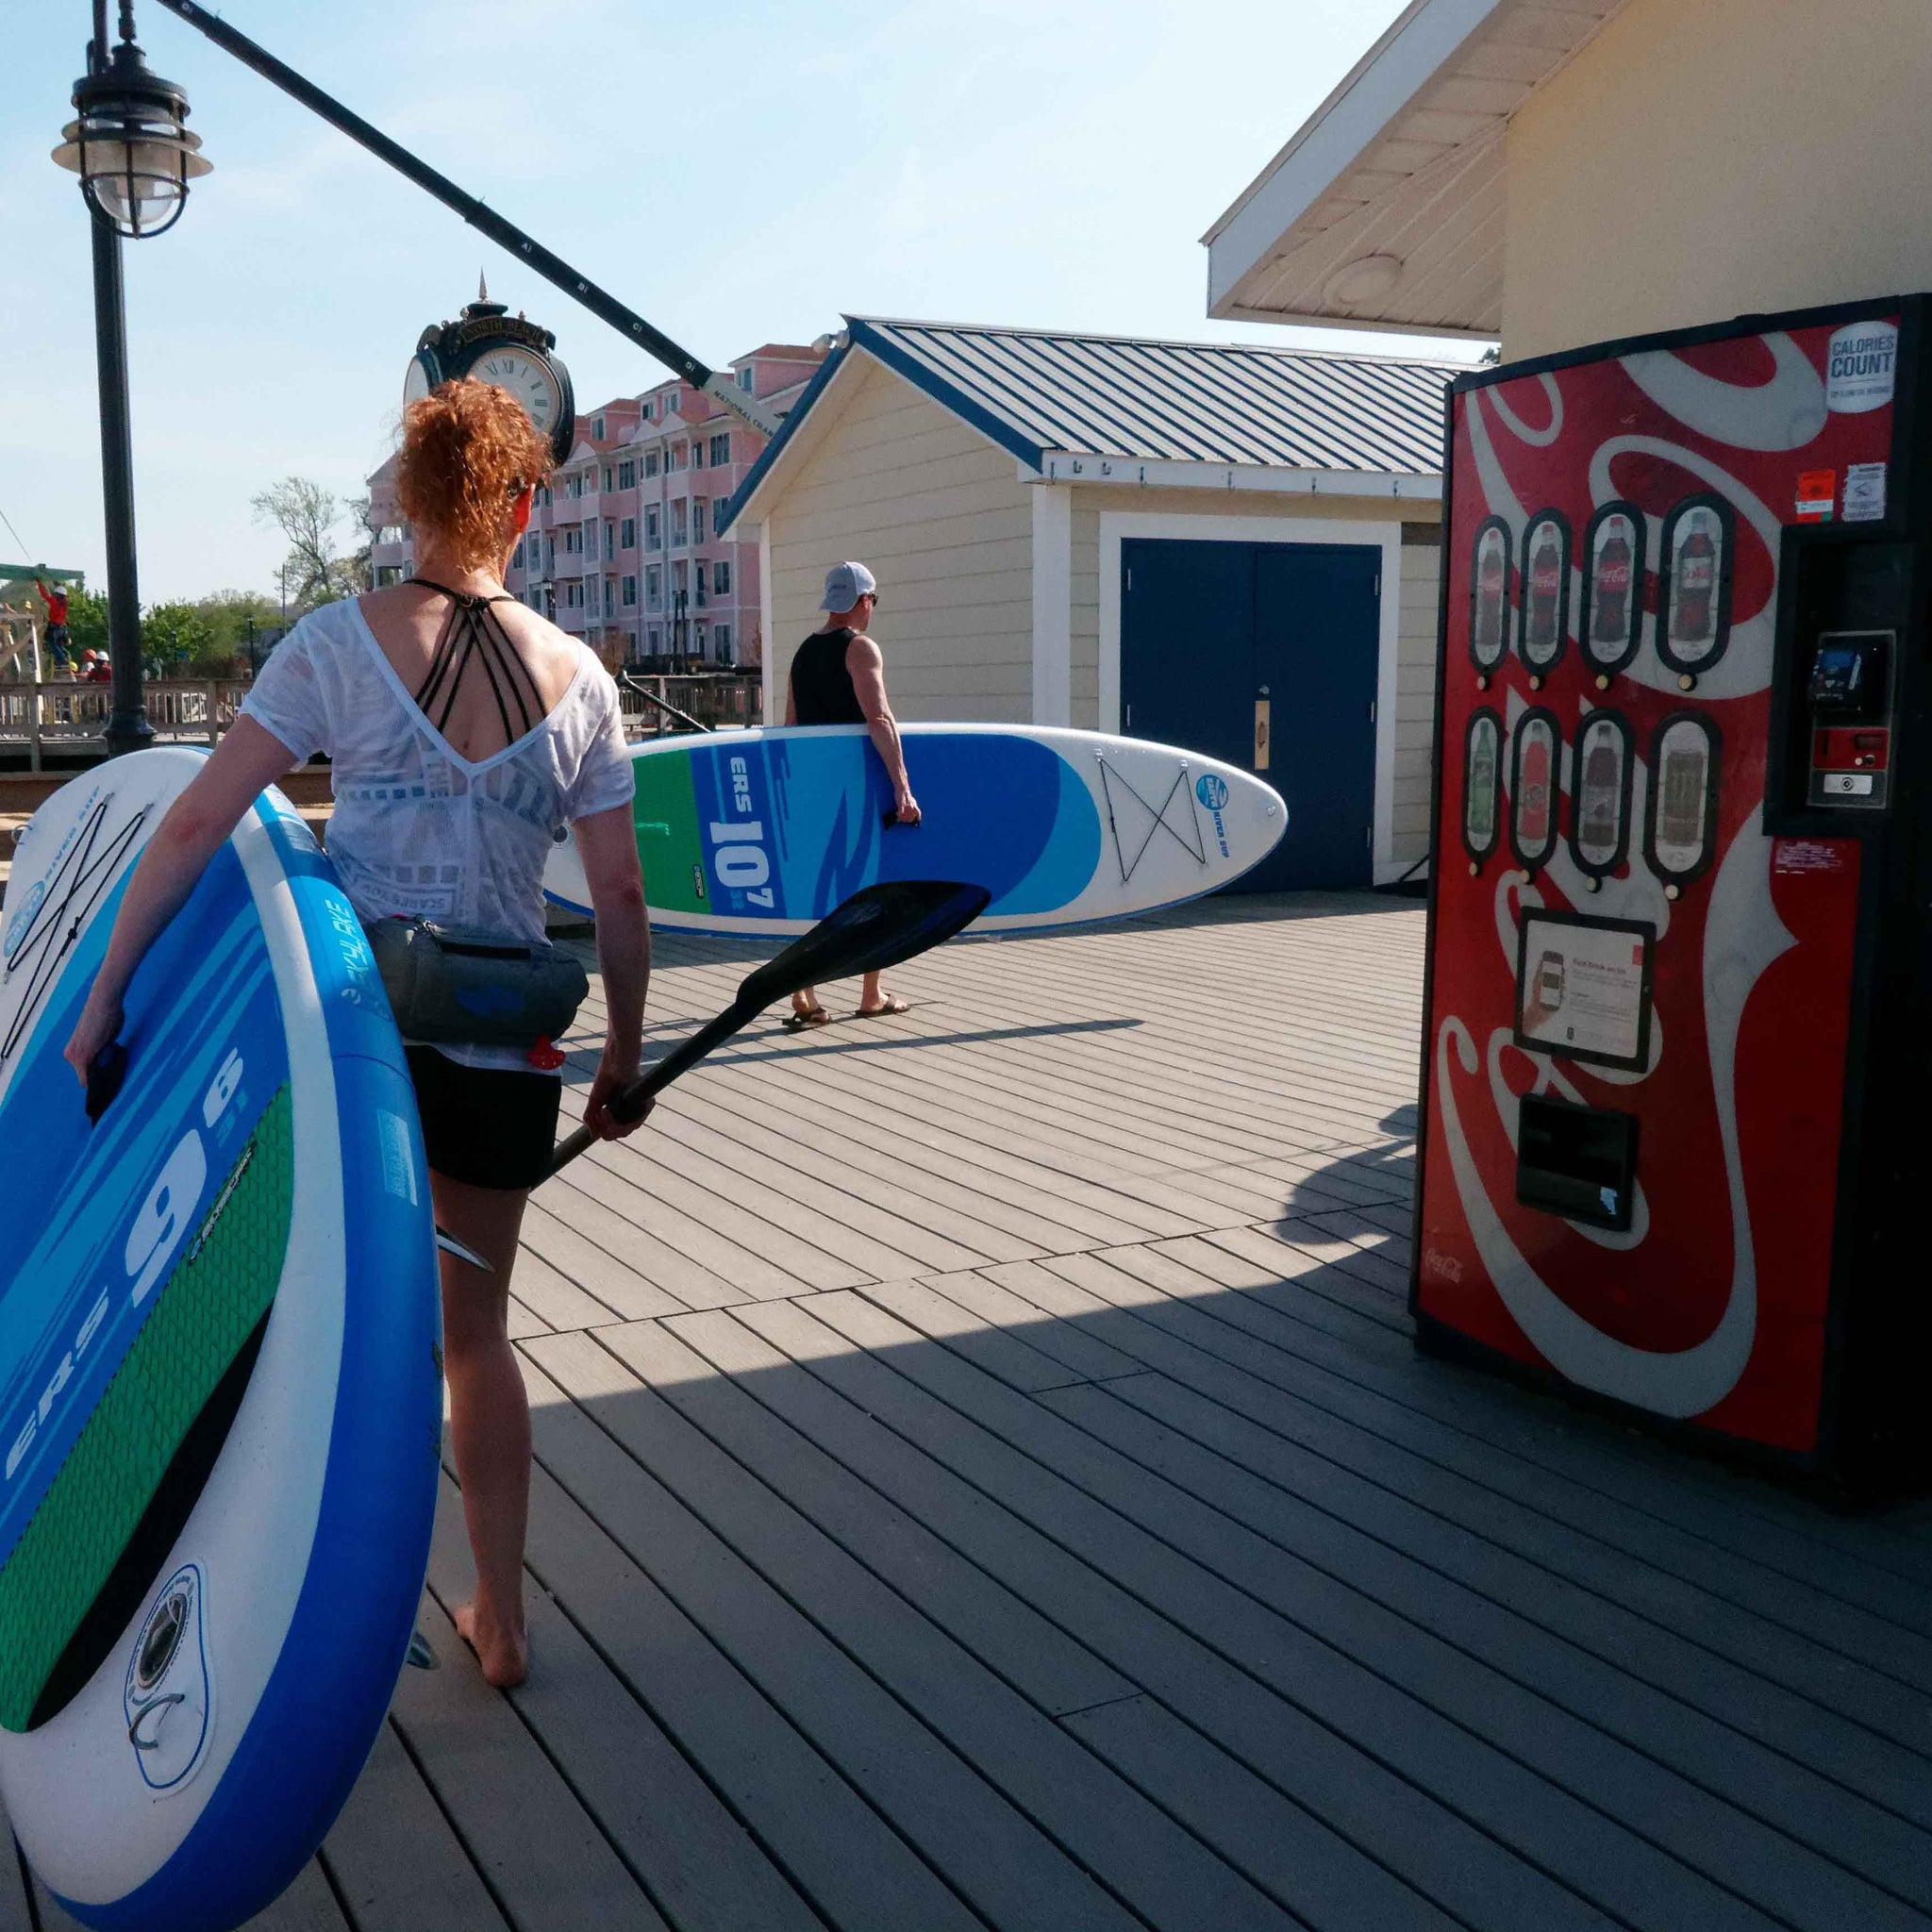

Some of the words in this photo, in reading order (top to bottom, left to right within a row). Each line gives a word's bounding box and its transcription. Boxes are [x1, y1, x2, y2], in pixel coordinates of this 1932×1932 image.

[1832, 334, 1895, 356] CALORIES
[1831, 353, 1893, 377] COUNT
[714, 391, 751, 422] NATIONAL
[753, 419, 774, 437] CRAN
[730, 757, 752, 812] ERS
[1212, 811, 1224, 839] RIVER
[6, 1285, 109, 1481] ERS
